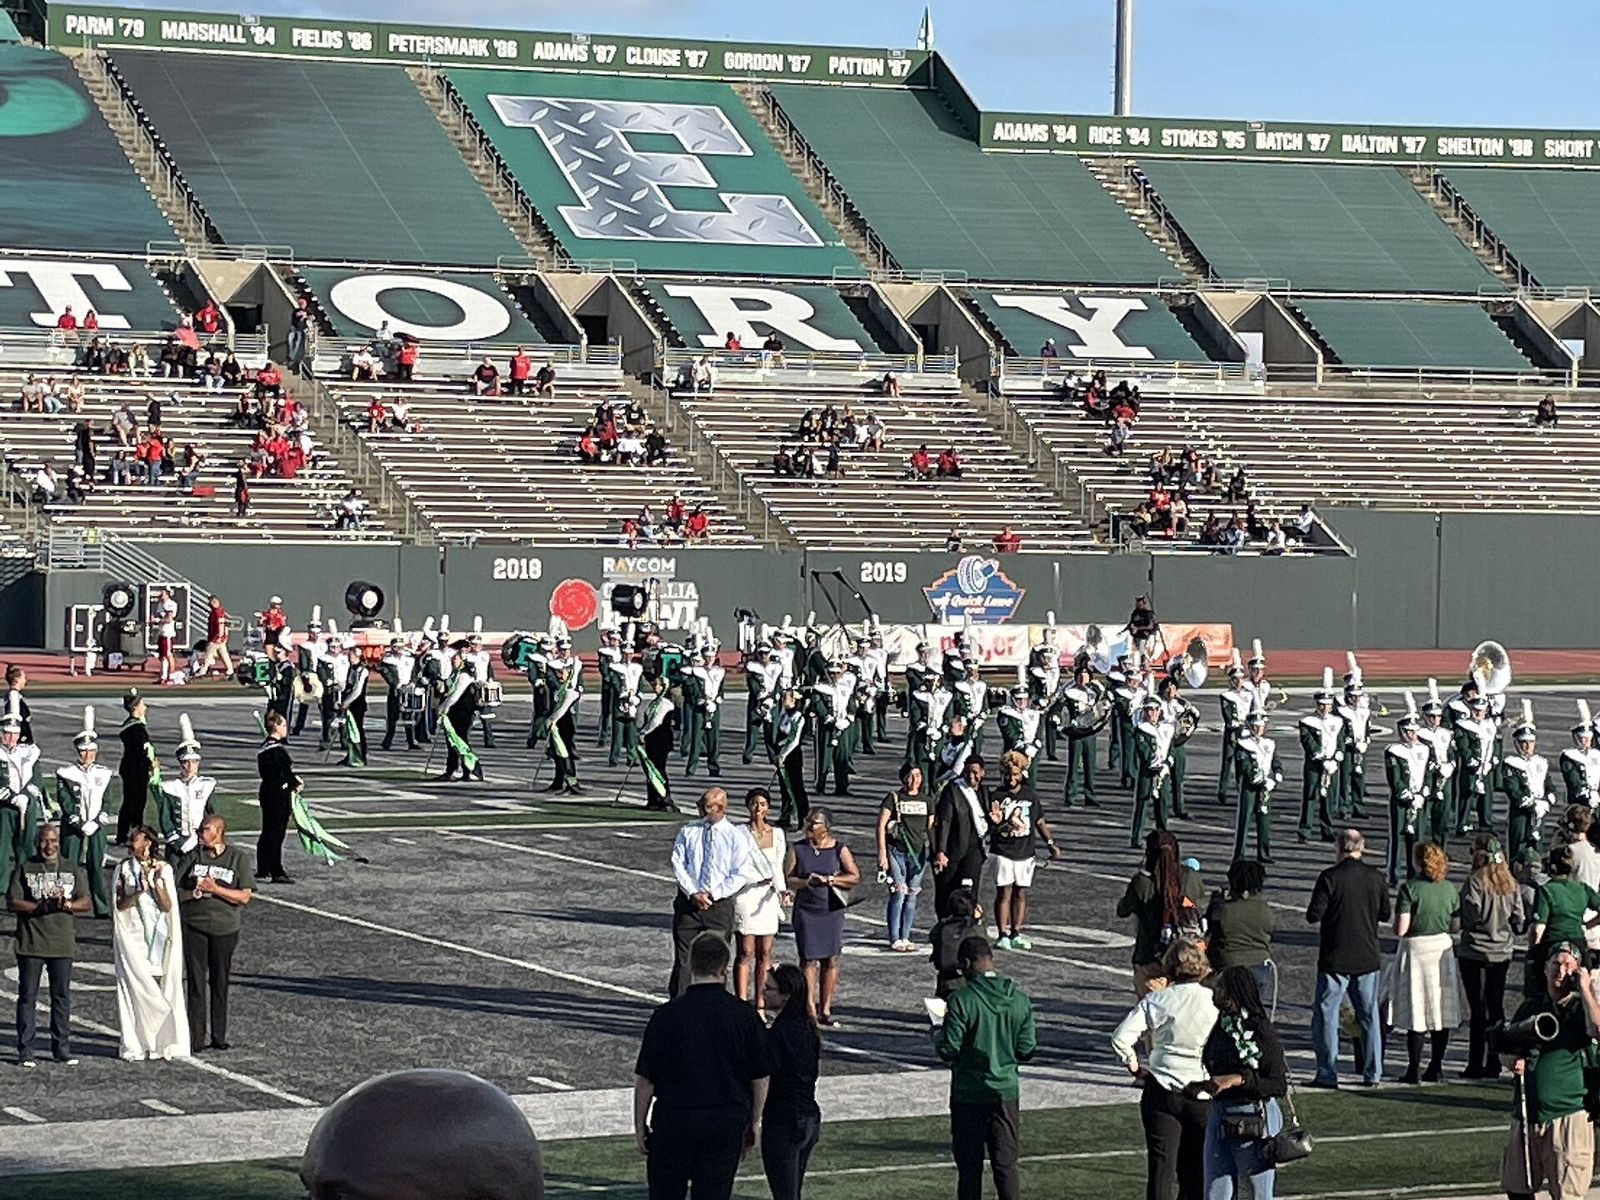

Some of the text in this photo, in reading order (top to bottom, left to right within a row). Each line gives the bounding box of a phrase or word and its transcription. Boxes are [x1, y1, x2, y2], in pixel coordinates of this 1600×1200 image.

[65, 14, 145, 38] PARM '79
[161, 20, 247, 43] MARSHALL
[249, 26, 276, 46] '84
[292, 28, 343, 49] FIELDS
[388, 33, 490, 57] PETERSMARK
[533, 41, 617, 64] ADAMS '87
[626, 46, 709, 68] CLOUSE '87
[724, 52, 812, 73] GORDON '87
[829, 56, 912, 77] PATTON '87
[992, 122, 1077, 144] ADAMS '94
[1088, 125, 1151, 146] RICE '94
[1161, 128, 1246, 149] STOKES '95
[1255, 131, 1331, 152] BATCH '97
[1341, 134, 1427, 154] DALTON '97
[1437, 137, 1504, 157] SHELTON
[1544, 139, 1594, 158] SHORT
[487, 94, 825, 246] E
[493, 558, 543, 579] 2018
[602, 557, 676, 573] RAYCOM
[860, 561, 907, 583] 2019
